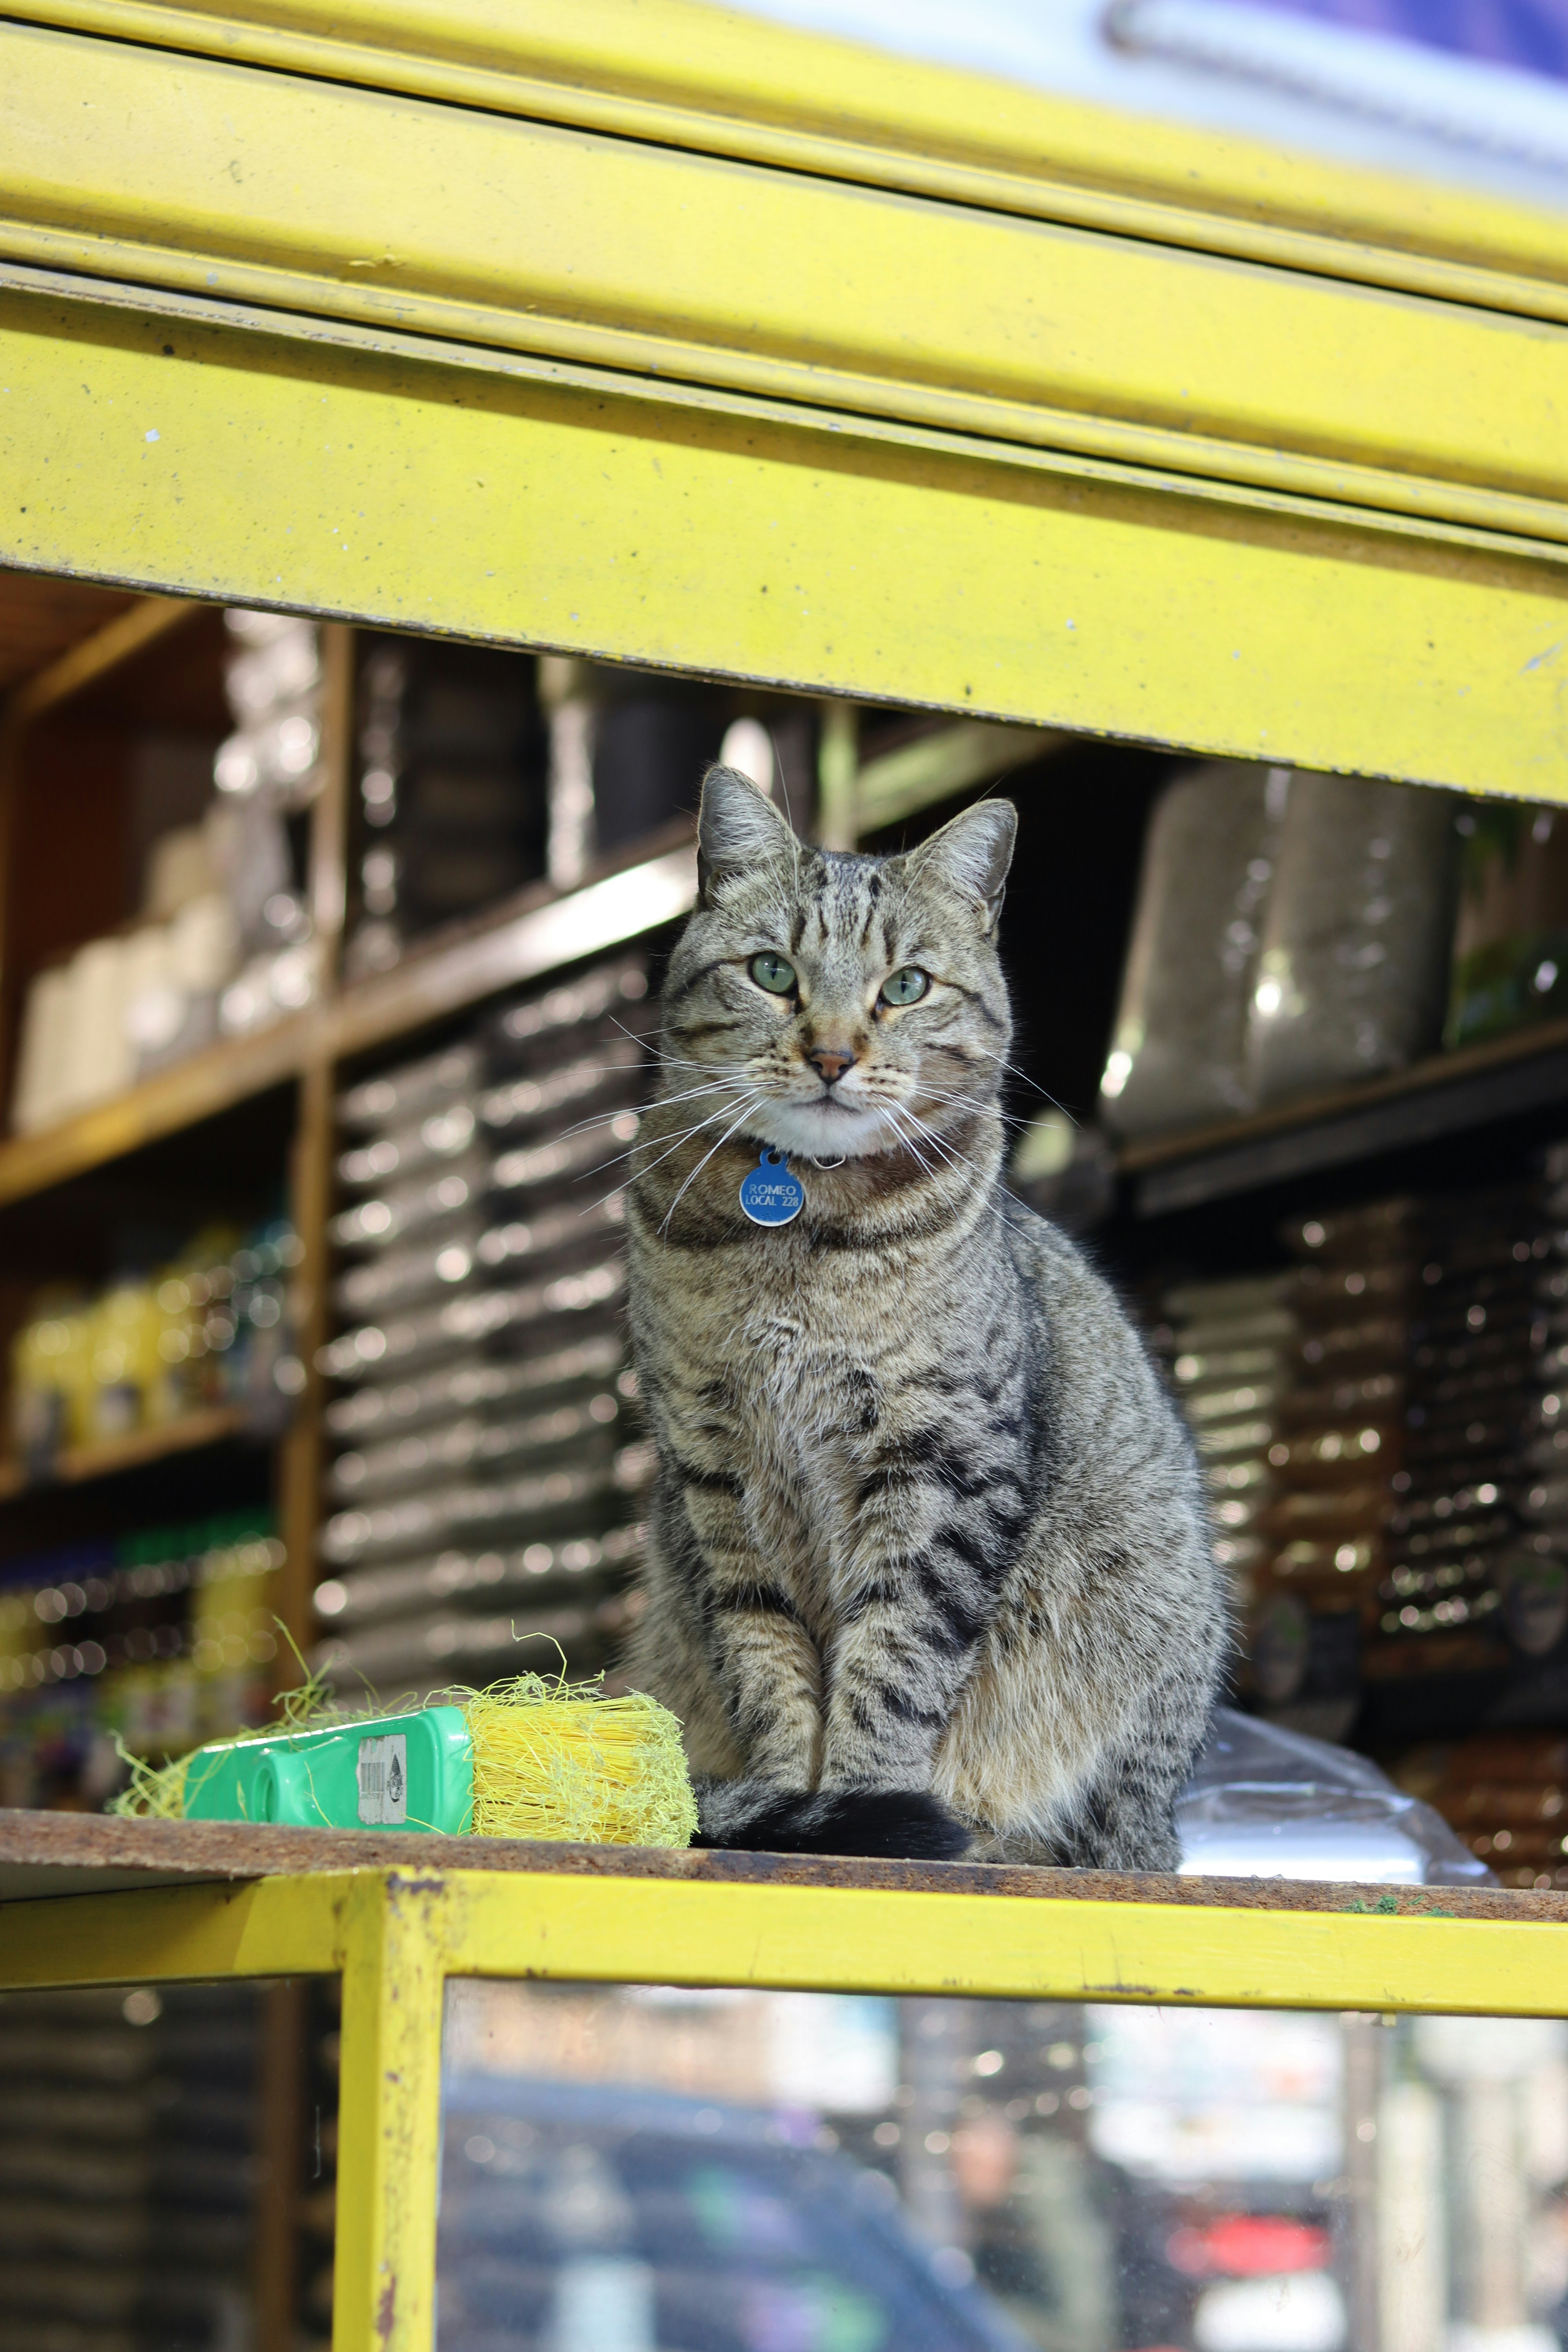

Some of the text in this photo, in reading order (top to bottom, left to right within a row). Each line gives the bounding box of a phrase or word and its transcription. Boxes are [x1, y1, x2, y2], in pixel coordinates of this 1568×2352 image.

[749, 1184, 796, 1196] ROMEO
[745, 1195, 799, 1207] LOCAL 228
